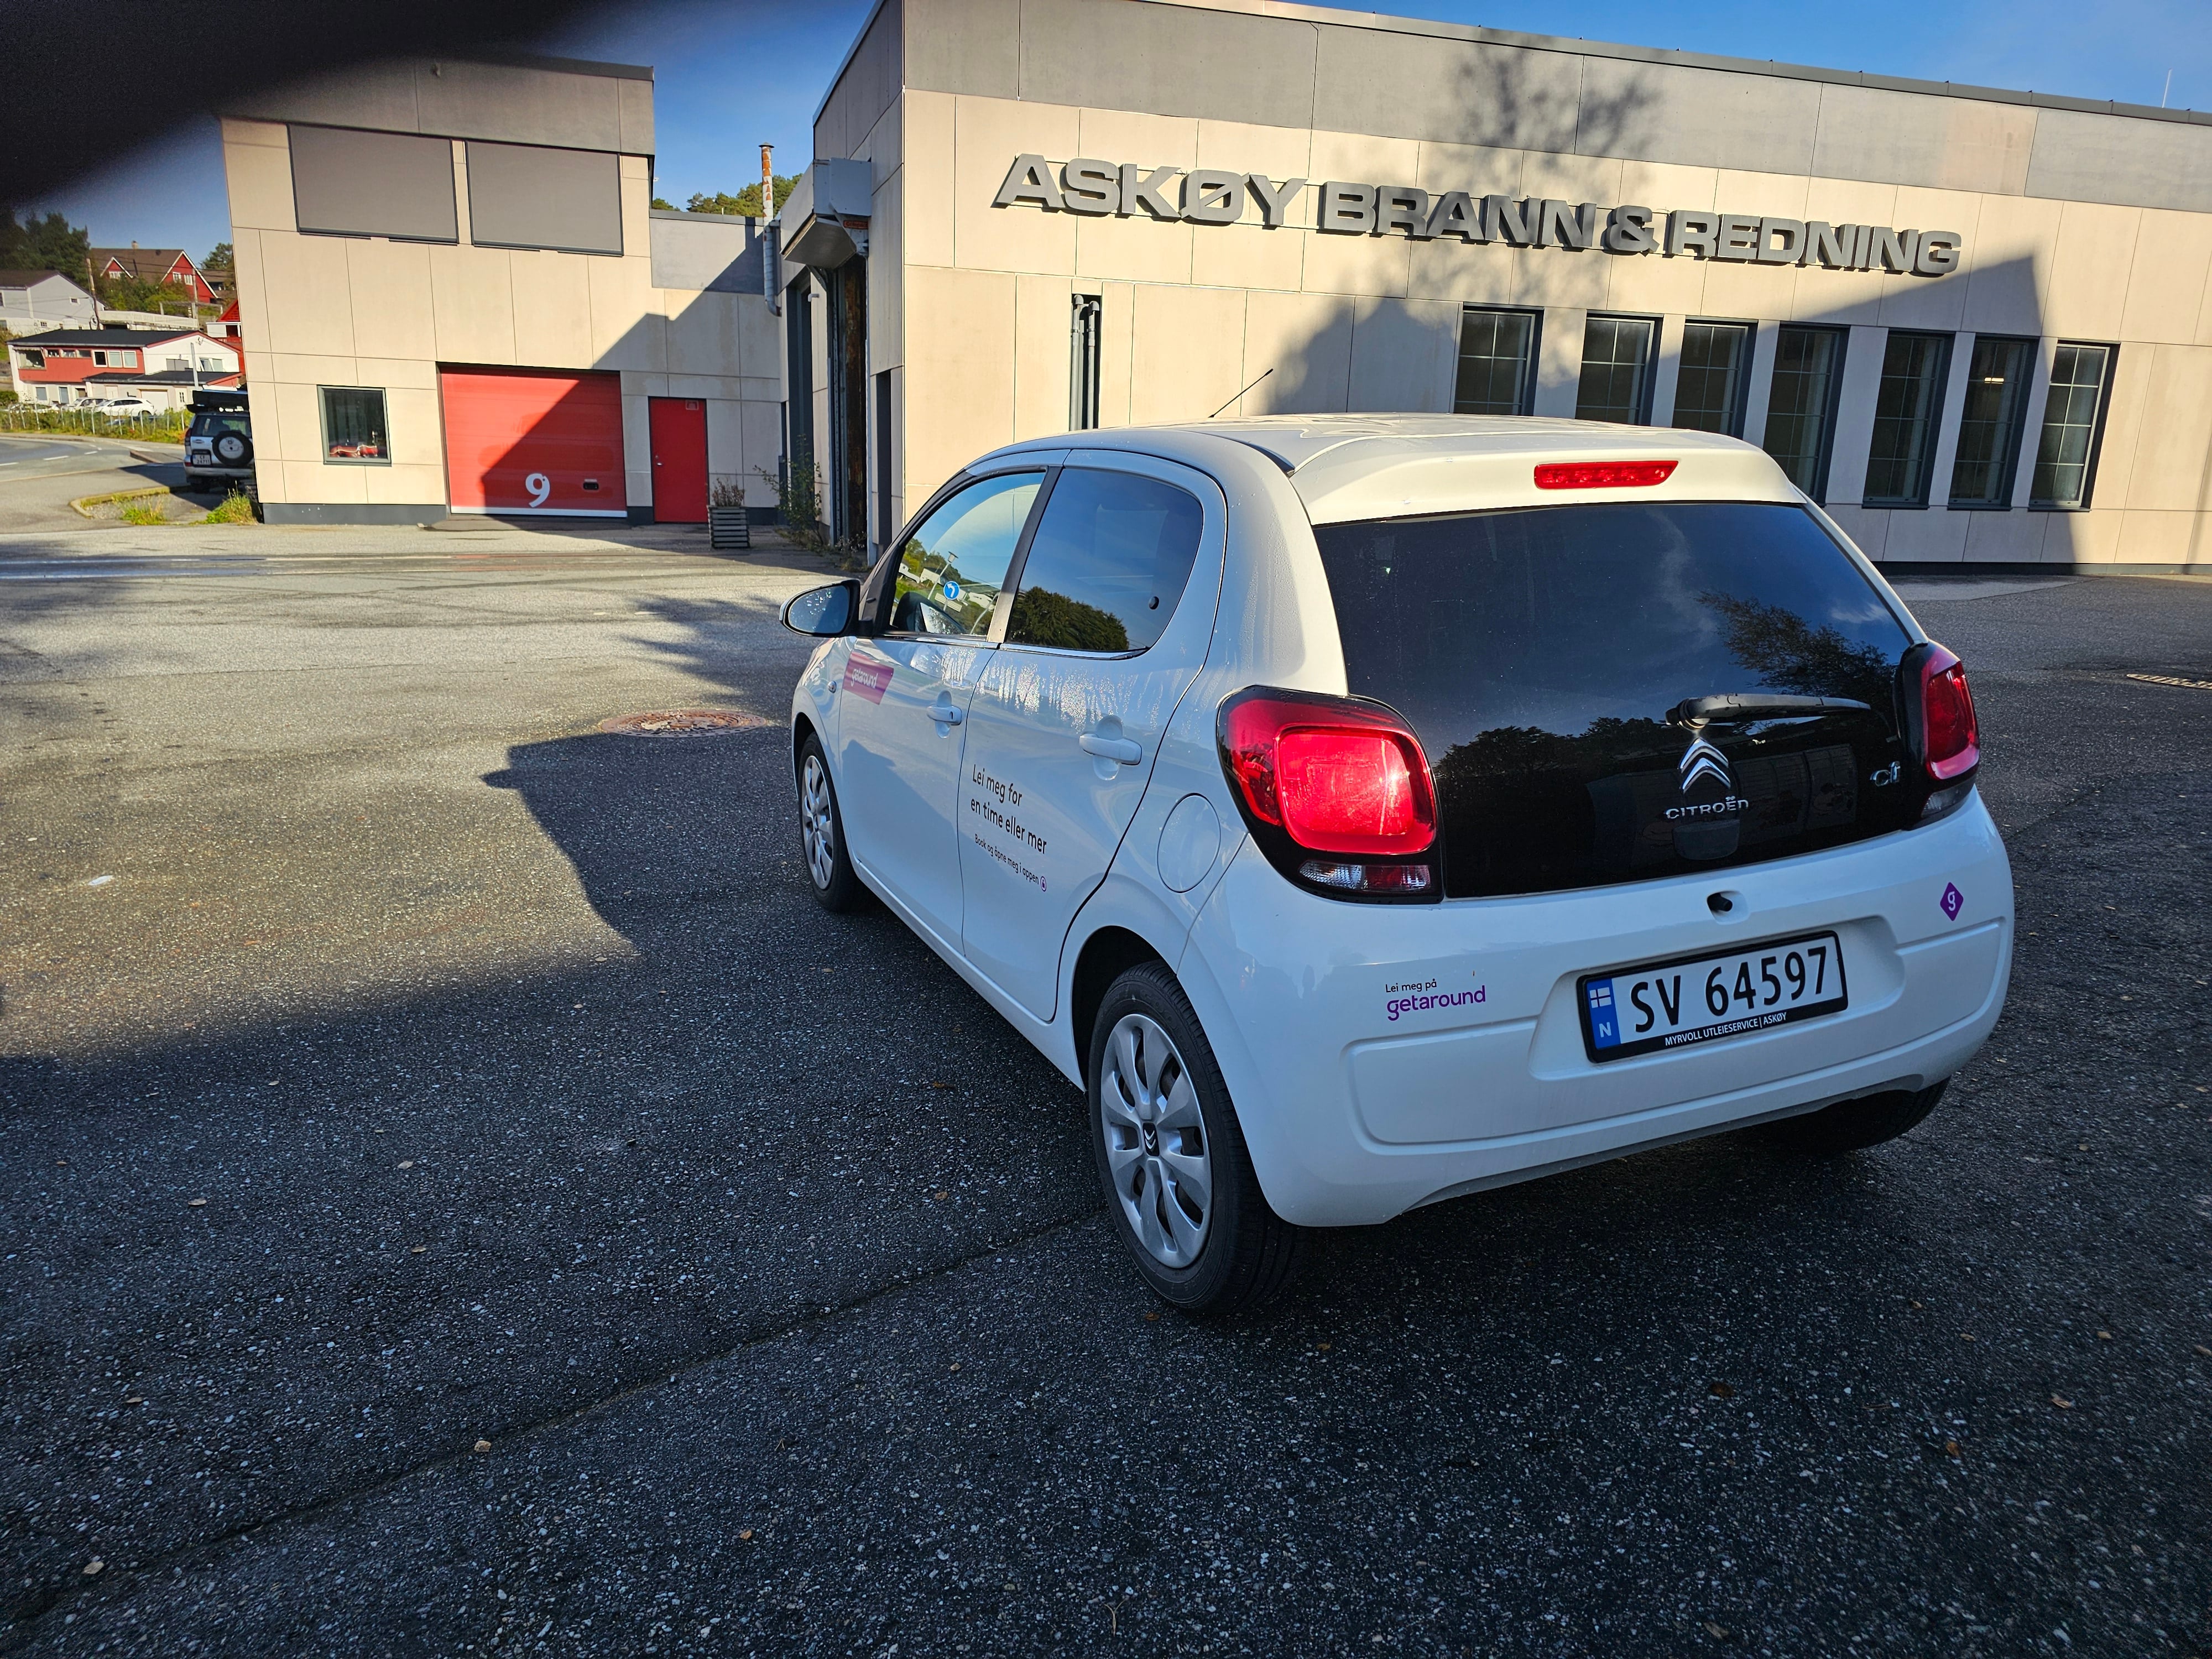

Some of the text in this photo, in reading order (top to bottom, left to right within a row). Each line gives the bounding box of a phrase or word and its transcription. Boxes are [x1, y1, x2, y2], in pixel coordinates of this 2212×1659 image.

[991, 153, 1962, 278] ASKØY BRANN & REDNING
[525, 473, 550, 508] 9
[851, 667, 878, 689] getaround
[973, 764, 1022, 806] Lei meg for
[971, 799, 1047, 854] en time eller mer
[975, 833, 1039, 884] Book og åpne meg i appen
[1385, 978, 1437, 993] Lei meg på
[1386, 985, 1486, 1021] getaround
[1630, 946, 1827, 1033] SV 64597
[1599, 1021, 1612, 1038] N
[1665, 1031, 1703, 1046] MYRVOLL
[1703, 1018, 1758, 1037] UTLEIESERVICE
[1763, 1012, 1787, 1025] ASKØY
